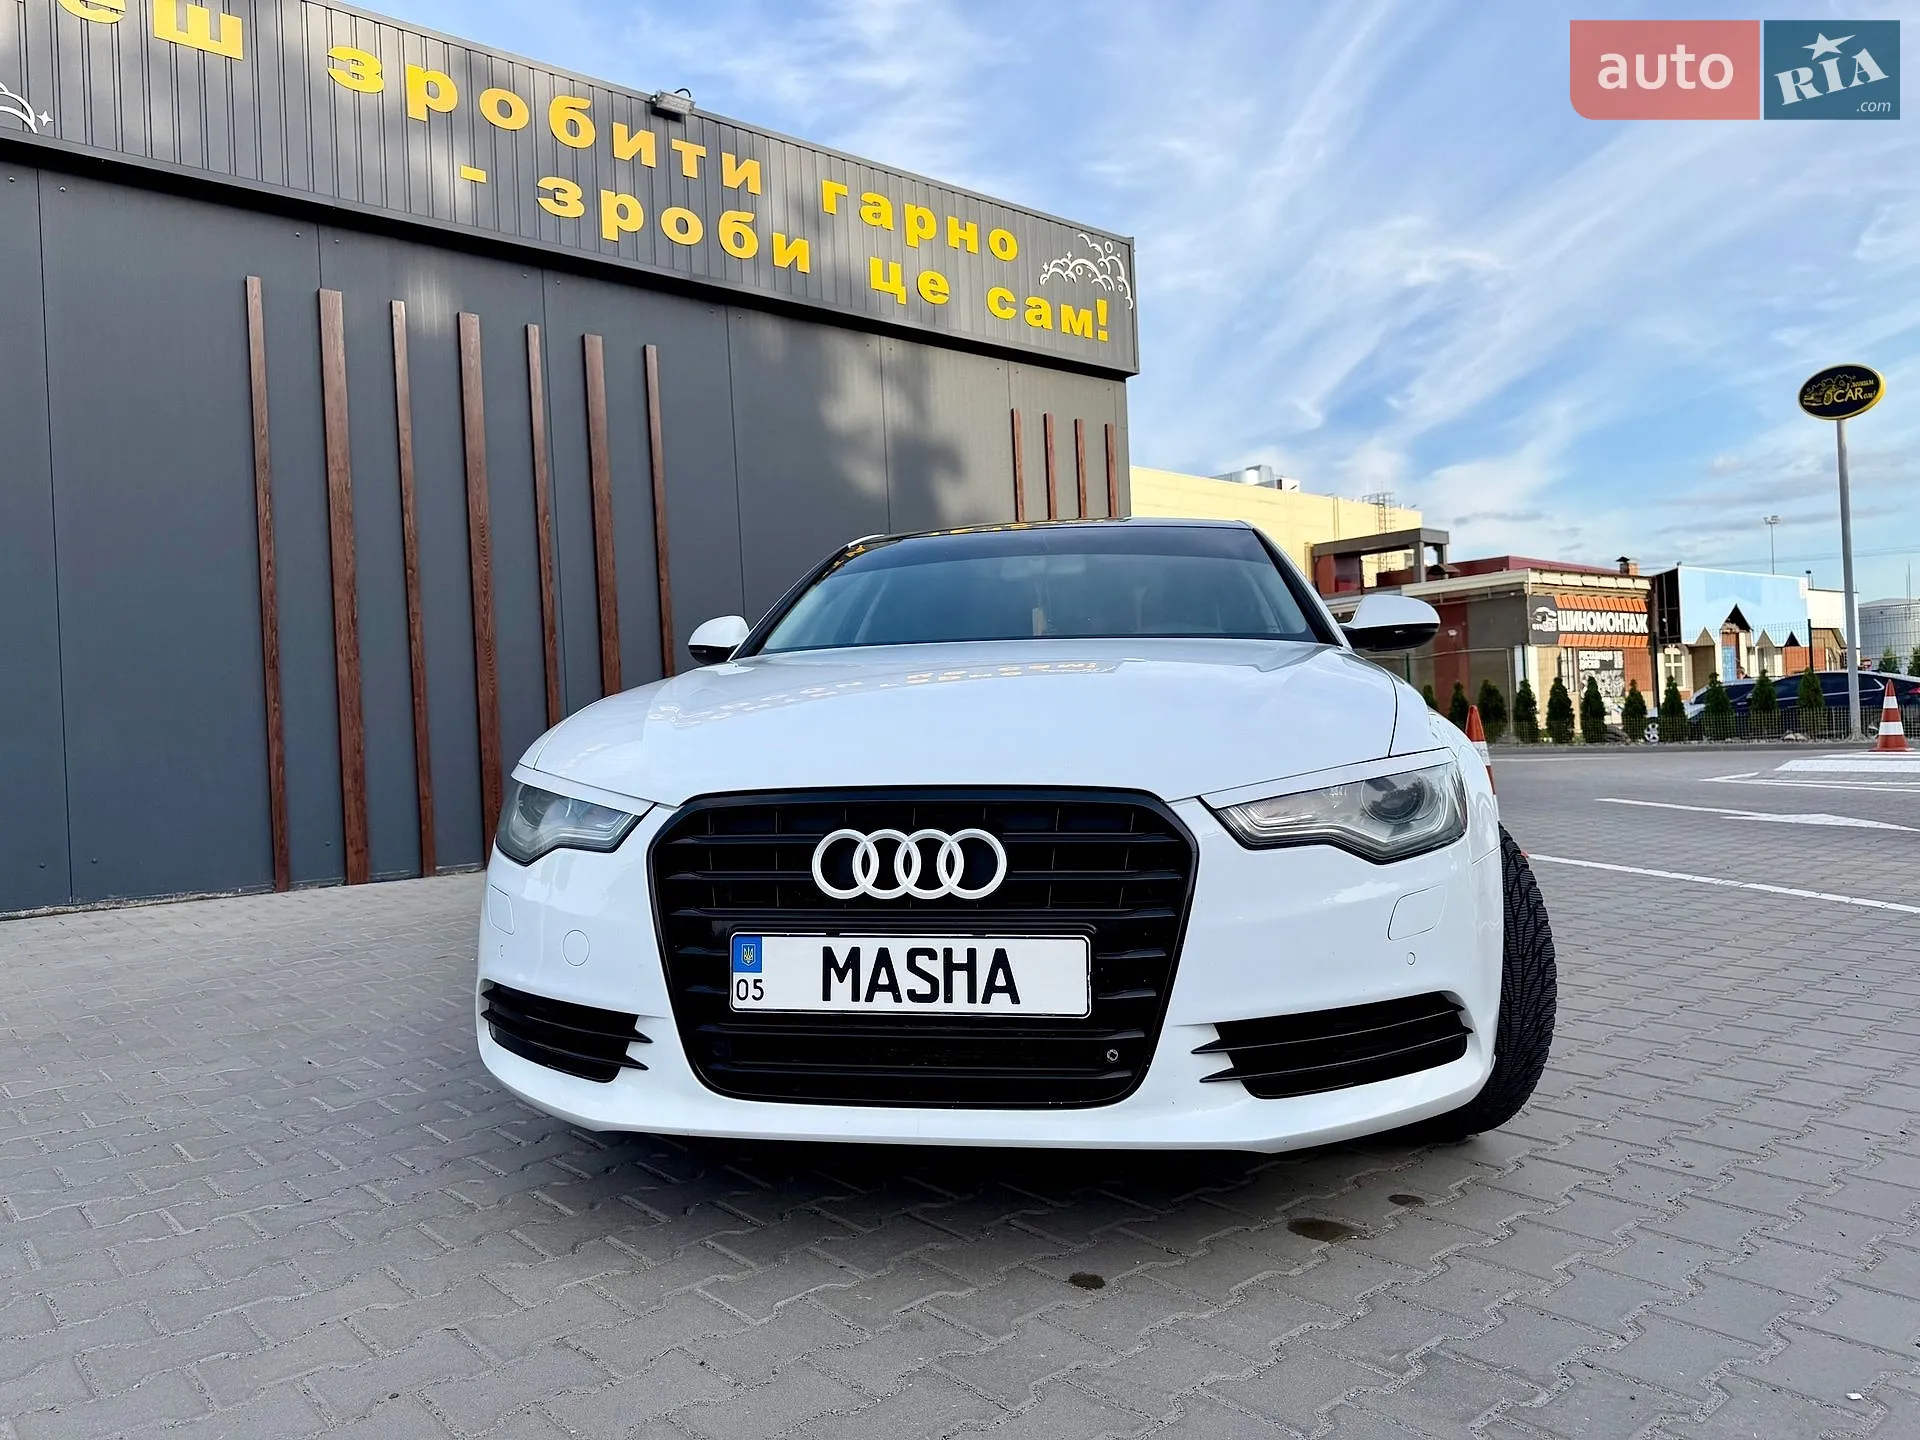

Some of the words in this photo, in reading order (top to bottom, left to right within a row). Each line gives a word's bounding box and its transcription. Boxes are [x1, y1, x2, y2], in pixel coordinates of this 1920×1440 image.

[327, 46, 762, 196] зробити
[821, 179, 1019, 262] гарно
[537, 176, 811, 274] зроби
[869, 256, 951, 305] це
[986, 286, 1110, 343] сам!
[1557, 610, 1649, 634] ШИНОМОНТАЖ
[736, 978, 765, 1002] 05
[822, 945, 1021, 1005] MASHA
